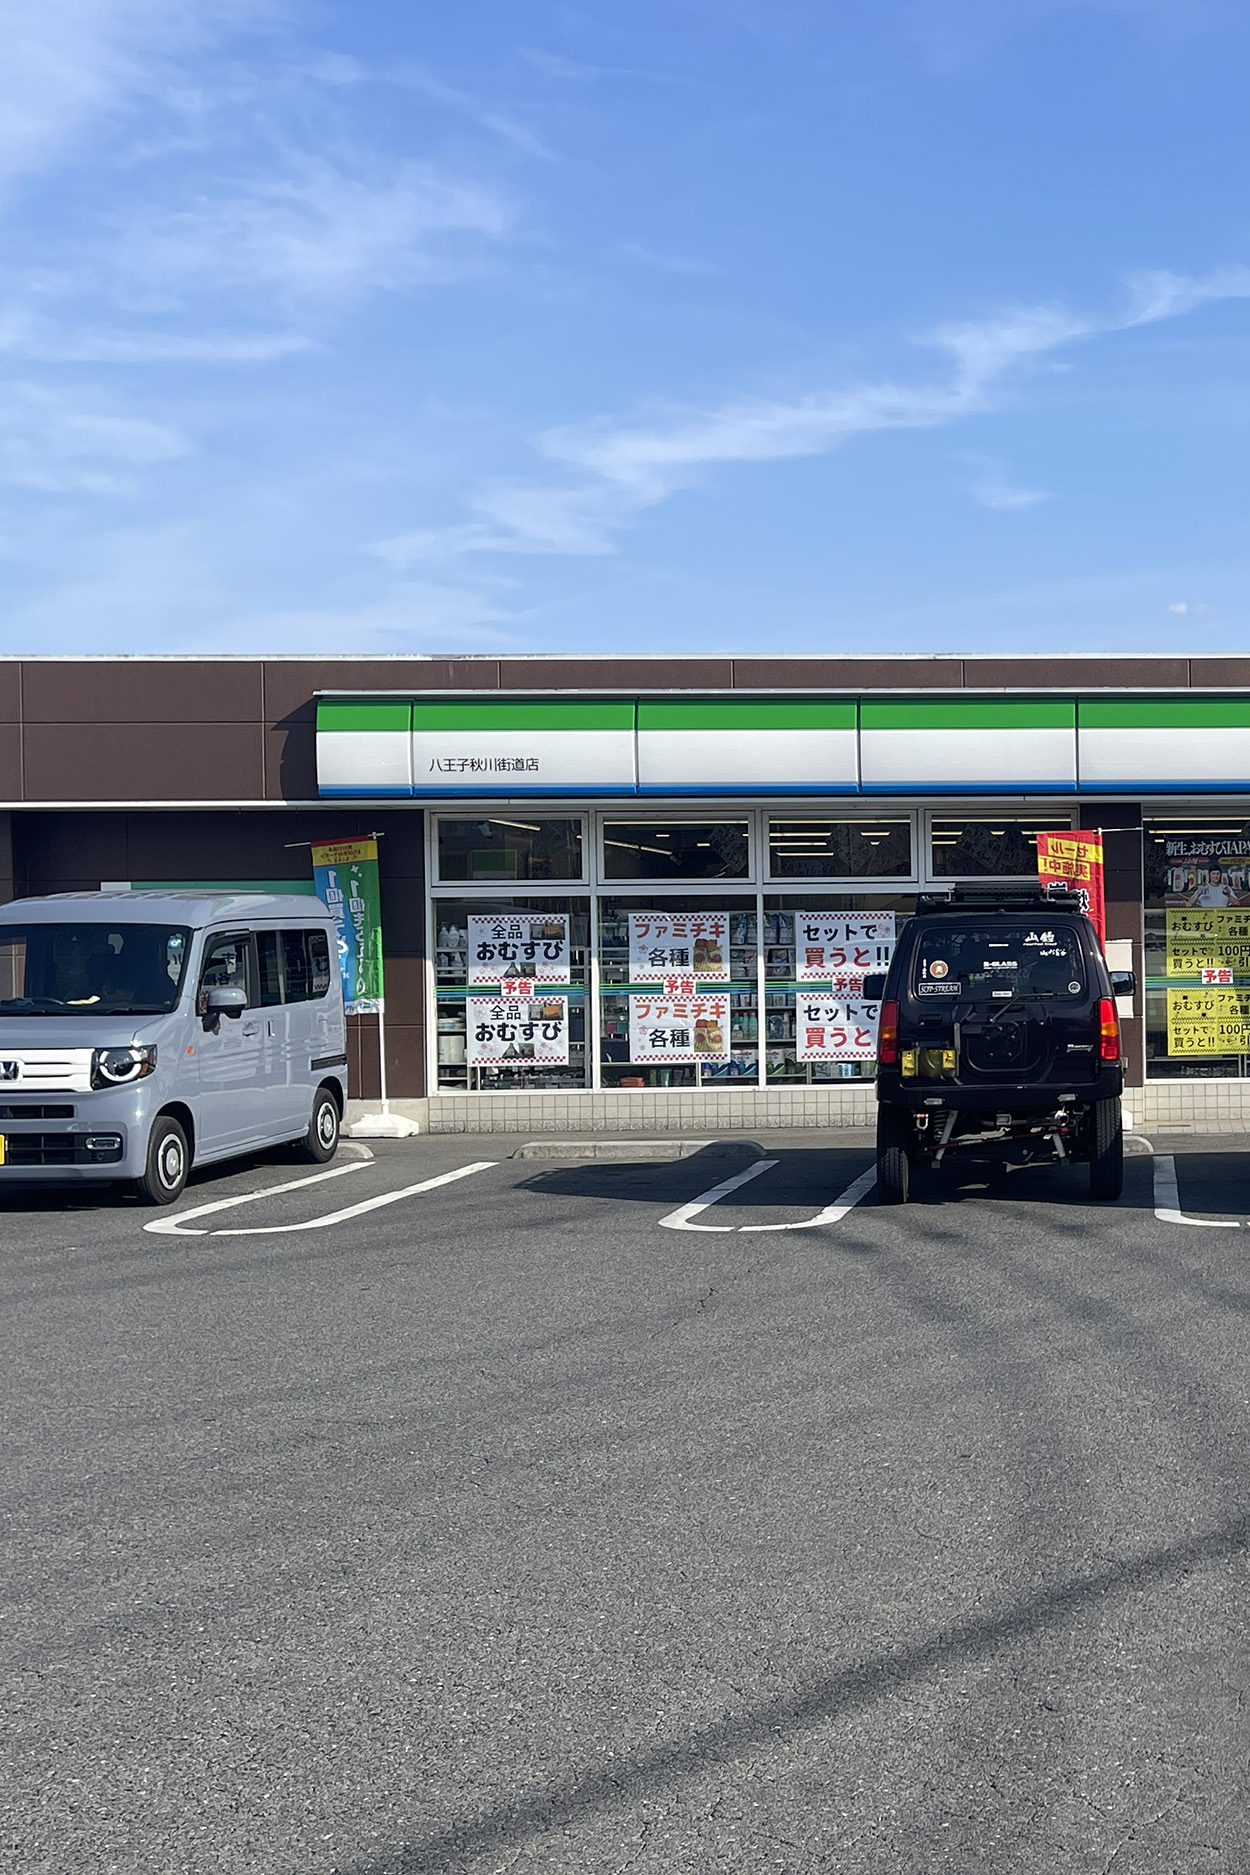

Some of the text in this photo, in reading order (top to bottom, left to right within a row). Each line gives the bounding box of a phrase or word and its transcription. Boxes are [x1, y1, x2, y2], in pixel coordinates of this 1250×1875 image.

[429, 758, 539, 772] 八王子秋川街道店
[491, 924, 523, 940] 全品
[635, 923, 725, 939] ファミチキ
[803, 924, 878, 942] セットで
[1171, 921, 1213, 932] おむすび
[1228, 926, 1248, 936] 各種
[476, 941, 564, 961] おむすび
[648, 948, 690, 967] 各種
[805, 946, 889, 969] 買うと!!
[1172, 946, 1208, 956] セットで
[1218, 945, 1250, 957] 100円
[1173, 958, 1213, 969] 買うと!!
[1203, 969, 1232, 983] 予告
[503, 981, 532, 995] 予告
[665, 981, 695, 994] 予告
[833, 978, 863, 992] 予告
[490, 1005, 521, 1020] 全品
[636, 1003, 726, 1019] ファミチキ
[1172, 1000, 1214, 1011] おむすび
[1229, 1004, 1250, 1015] 各種
[803, 1004, 878, 1022] セットで
[475, 1022, 562, 1042] おむすび
[1173, 1026, 1208, 1034] セットで
[648, 1029, 690, 1048] 各種
[805, 1027, 872, 1049] 買うと
[1174, 1036, 1215, 1048] 買うと!!
